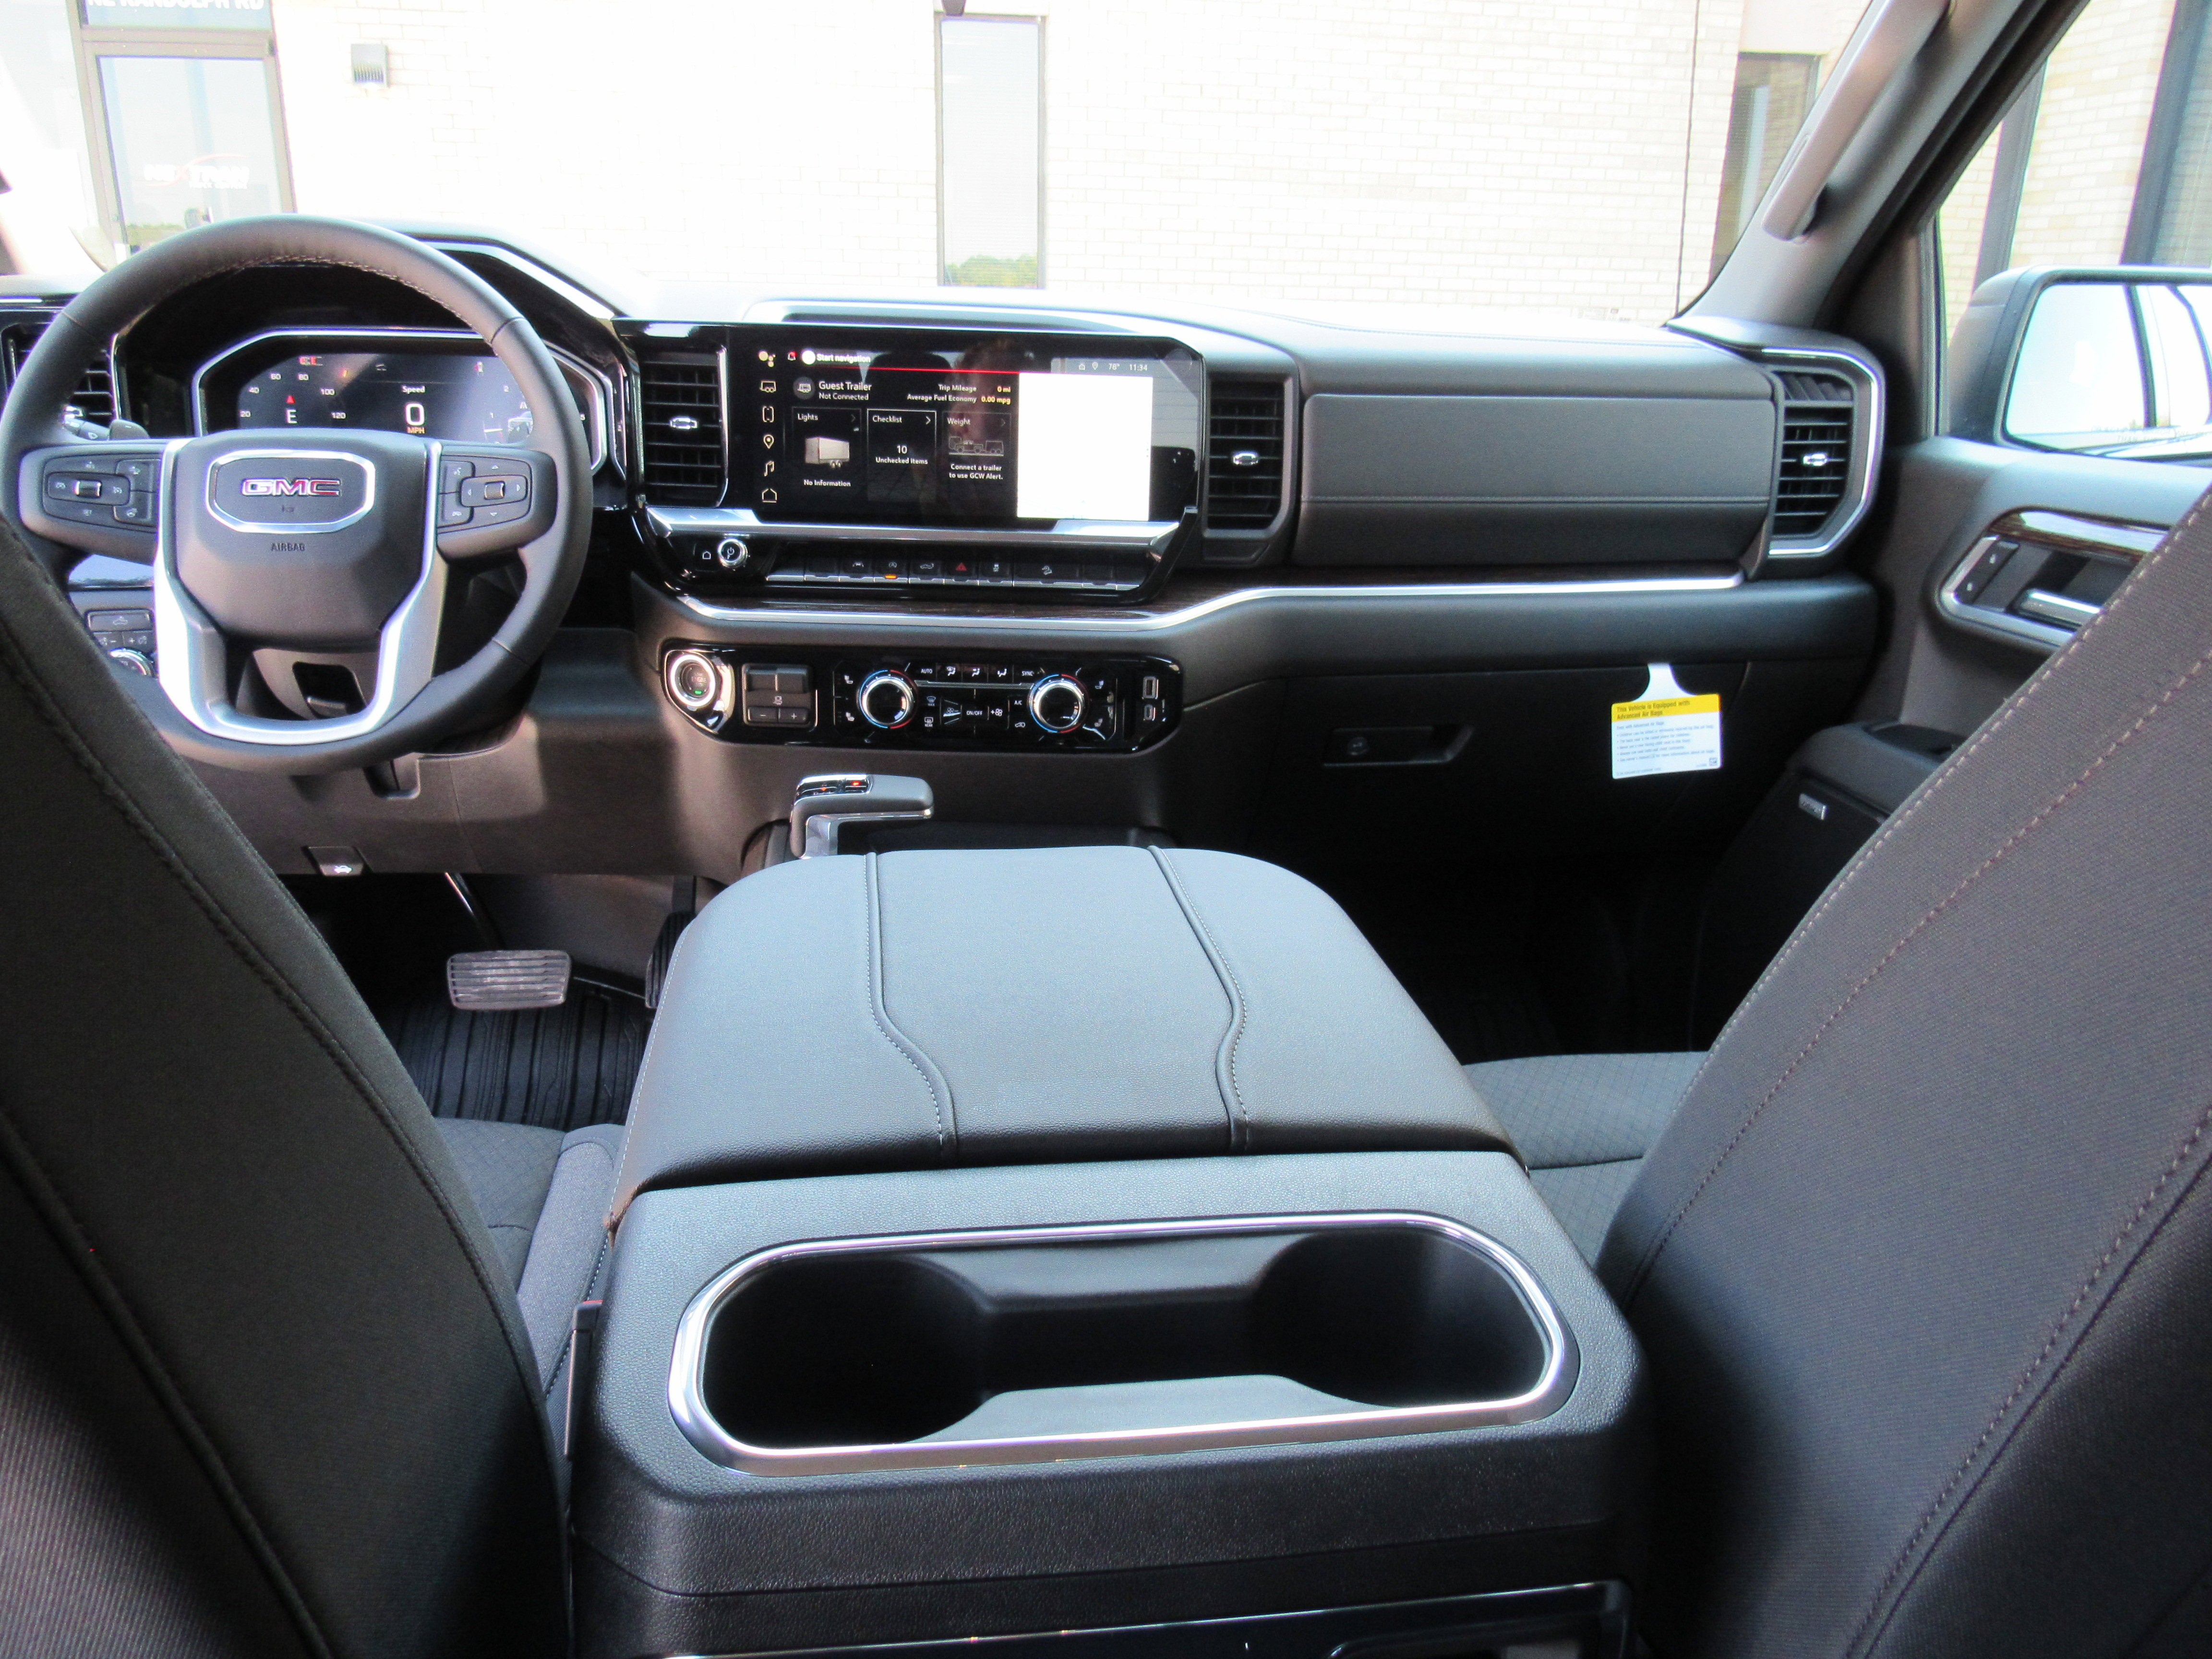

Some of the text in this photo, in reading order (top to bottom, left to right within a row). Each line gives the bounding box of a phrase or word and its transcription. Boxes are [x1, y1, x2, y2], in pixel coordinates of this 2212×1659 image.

[835, 354, 871, 364] navigation
[402, 385, 425, 394] Speed
[818, 381, 872, 391] Guest Trailer
[938, 384, 977, 393] Trip Mileage
[907, 394, 932, 402] Average
[948, 395, 977, 404] Economy
[286, 409, 298, 424] E
[405, 401, 425, 426] 0
[797, 413, 818, 422] Lights
[947, 418, 971, 426] Weight
[897, 445, 908, 454] 10
[240, 477, 341, 496] GMC
[271, 542, 305, 552] AIRBAG
